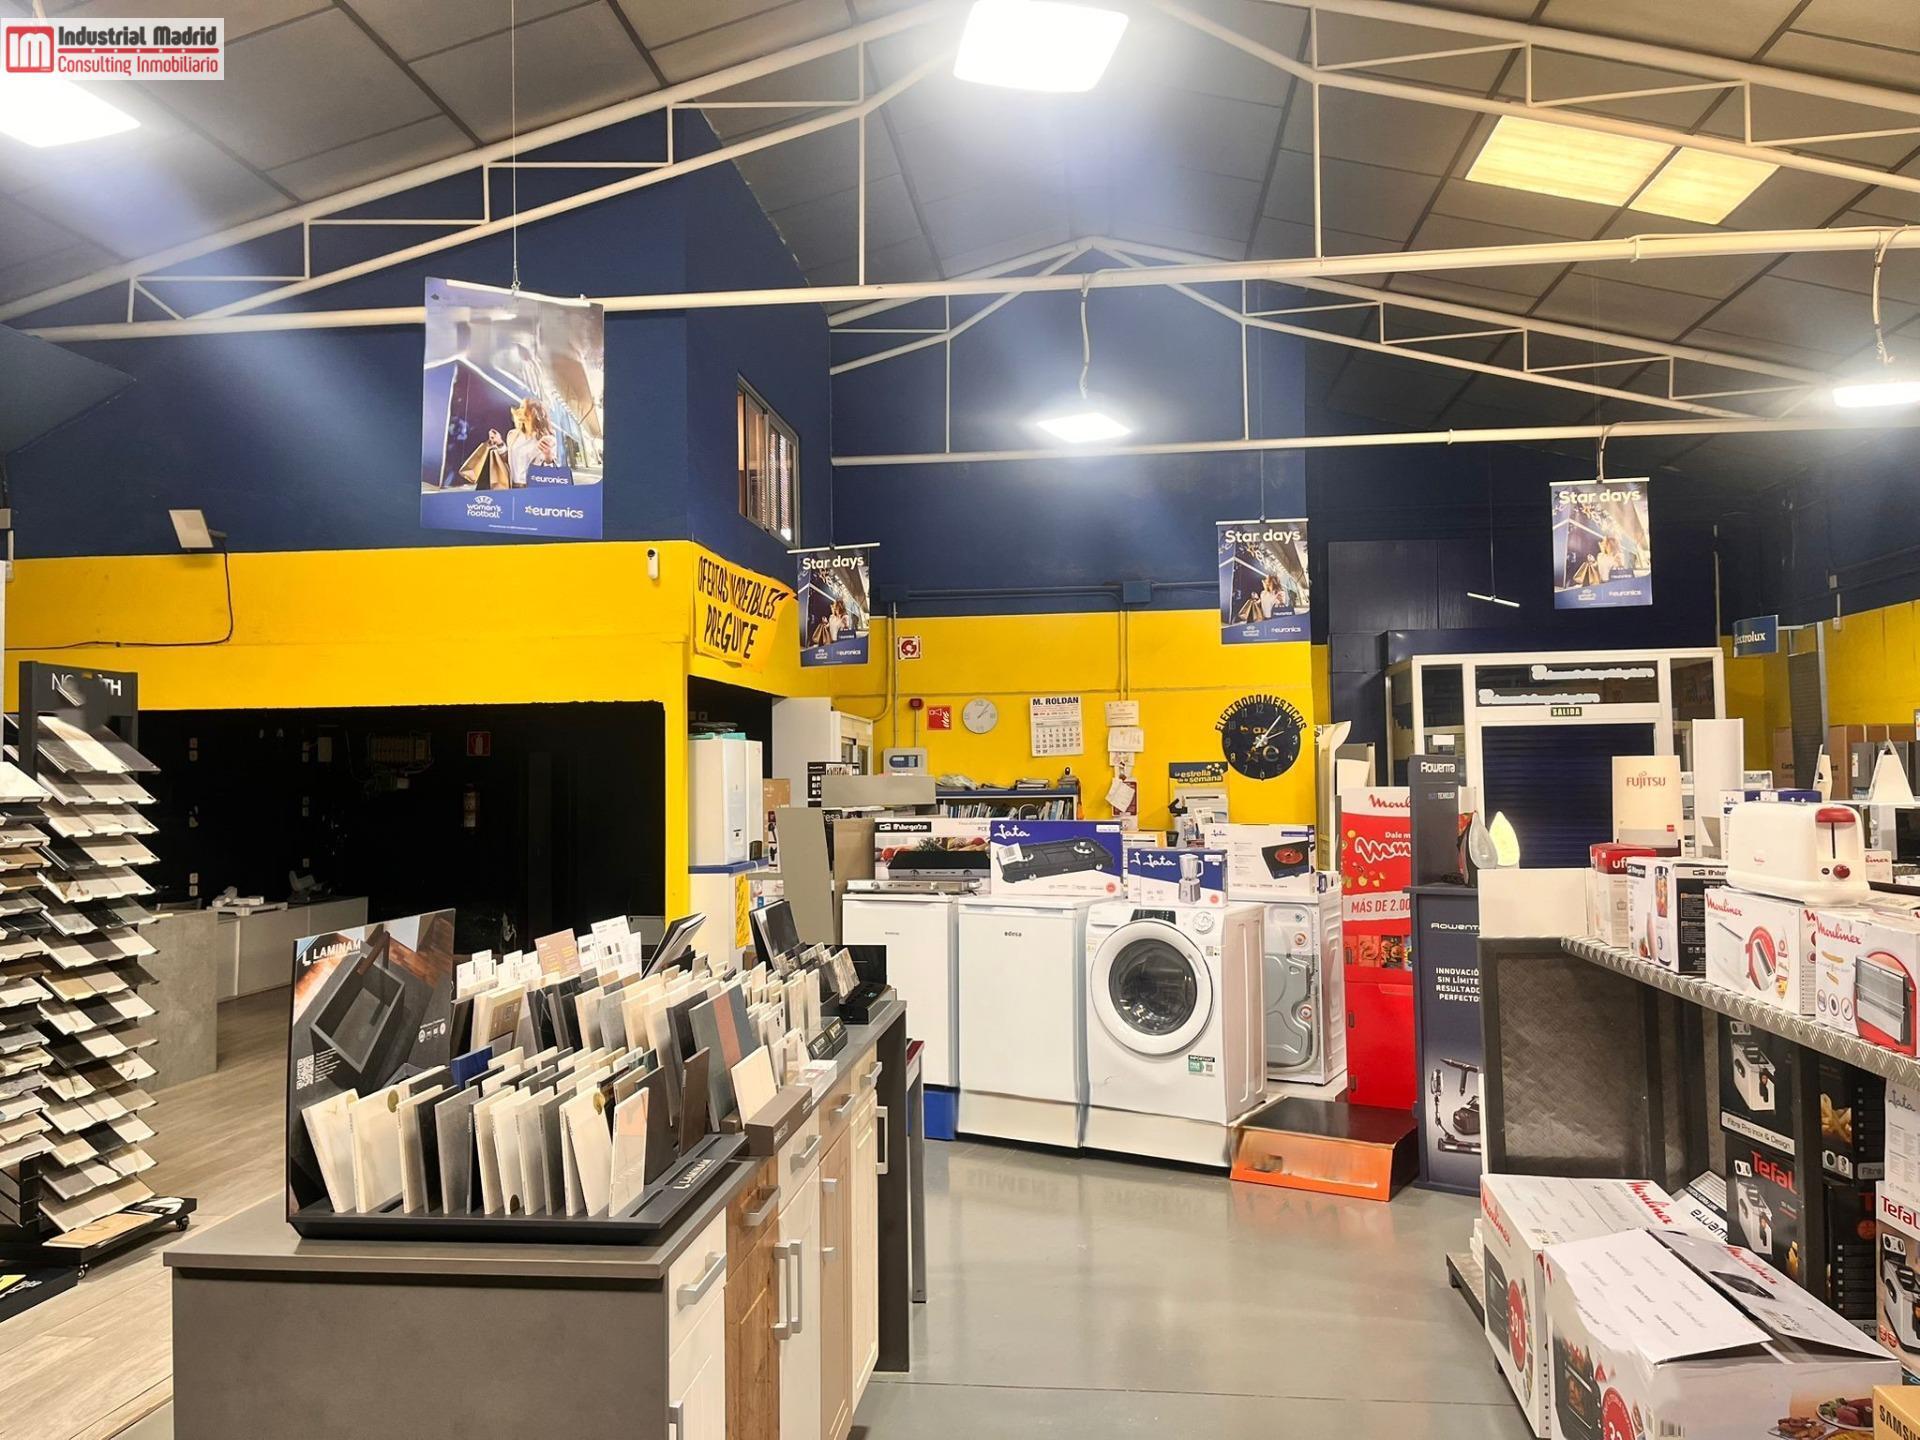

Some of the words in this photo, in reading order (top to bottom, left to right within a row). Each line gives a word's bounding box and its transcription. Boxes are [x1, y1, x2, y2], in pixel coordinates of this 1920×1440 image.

[535, 475, 569, 485] euronics
[1559, 490, 1597, 504] Star
[1599, 489, 1641, 504] days
[532, 505, 584, 519] euronics
[1225, 530, 1259, 543] Star
[1262, 529, 1301, 544] days
[802, 557, 829, 570] Star
[832, 555, 865, 570] days
[1045, 697, 1079, 705] ROLDAN
[1215, 694, 1307, 731] ELECTRODOMESTICOS
[1552, 708, 1580, 716] SALIDA
[1180, 770, 1211, 778] estrella
[1421, 761, 1456, 773] Rowenta
[1626, 775, 1666, 789] FUJITSU
[1351, 898, 1373, 913] MÁS
[1375, 899, 1388, 911] DE
[1431, 922, 1480, 930] Rowent
[1816, 915, 1862, 945] Moulinex
[313, 940, 361, 958] LAMINAM
[1452, 975, 1480, 985] LÍMITE
[1439, 993, 1480, 1002] PERFECTO
[1751, 1151, 1797, 1194] Tefal
[1881, 1195, 1920, 1231] Tefal
